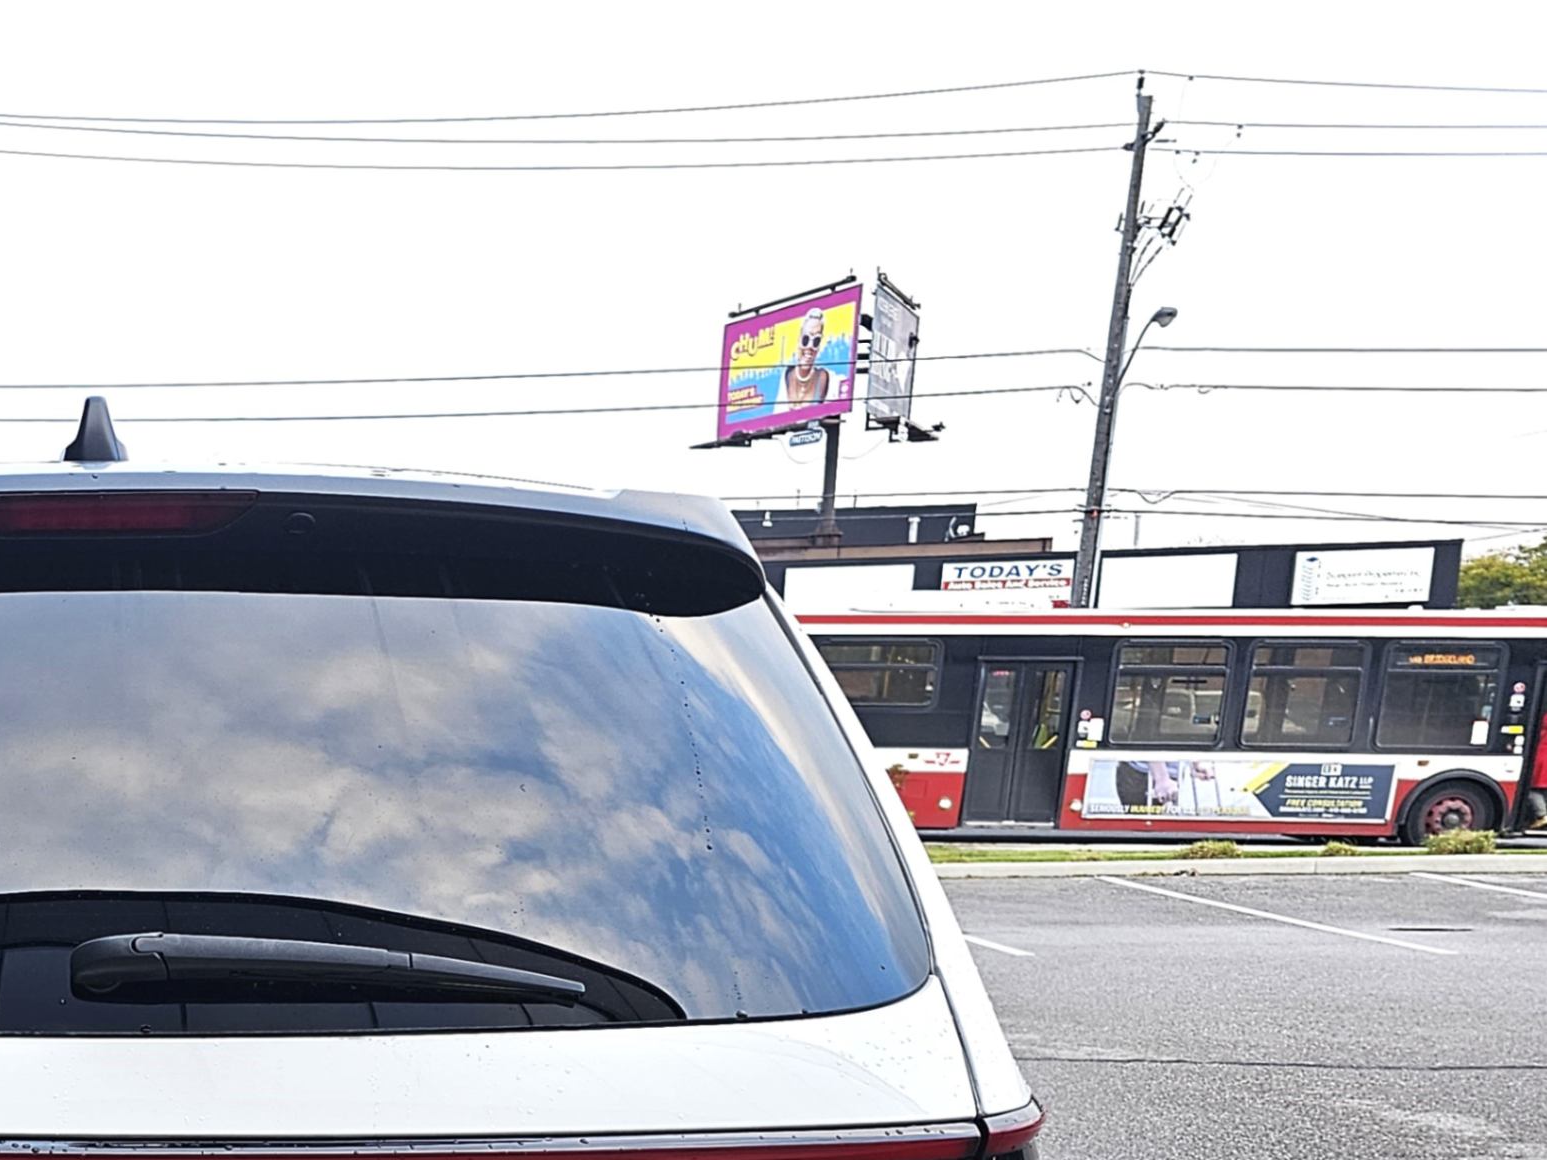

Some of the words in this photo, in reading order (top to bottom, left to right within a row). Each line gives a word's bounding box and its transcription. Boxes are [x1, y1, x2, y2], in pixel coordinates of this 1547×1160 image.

[953, 563, 1064, 579] TODAY'S
[1285, 775, 1327, 788] SINGER
[1328, 776, 1359, 789] KATZ
